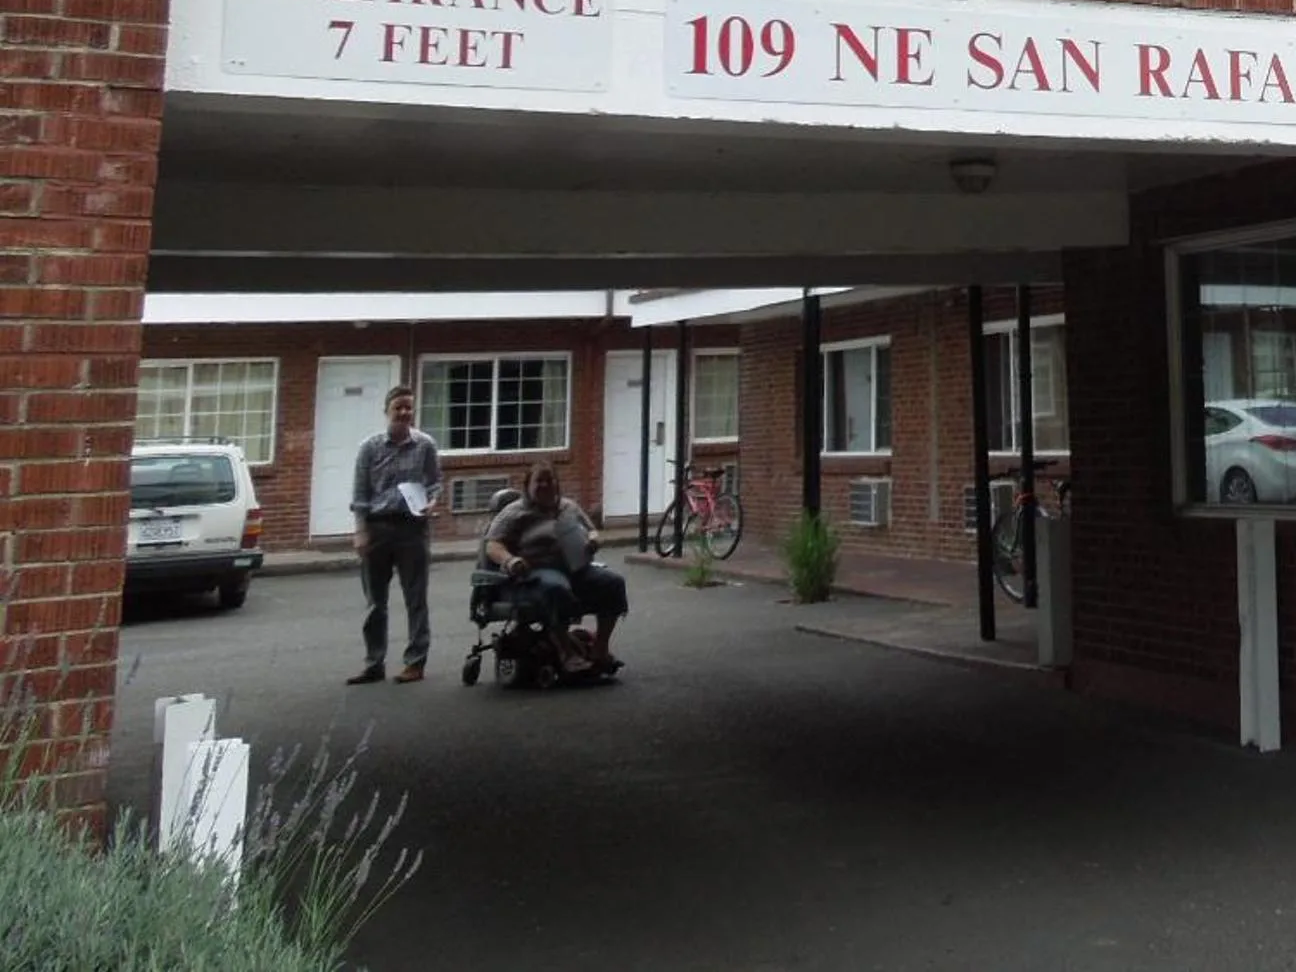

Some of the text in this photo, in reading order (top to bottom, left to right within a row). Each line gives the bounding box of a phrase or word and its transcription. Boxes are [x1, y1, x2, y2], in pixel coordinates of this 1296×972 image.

[328, 21, 524, 69] 7 FEET
[684, 15, 796, 78] 109
[829, 23, 935, 86] NE
[967, 32, 1104, 93] SAN
